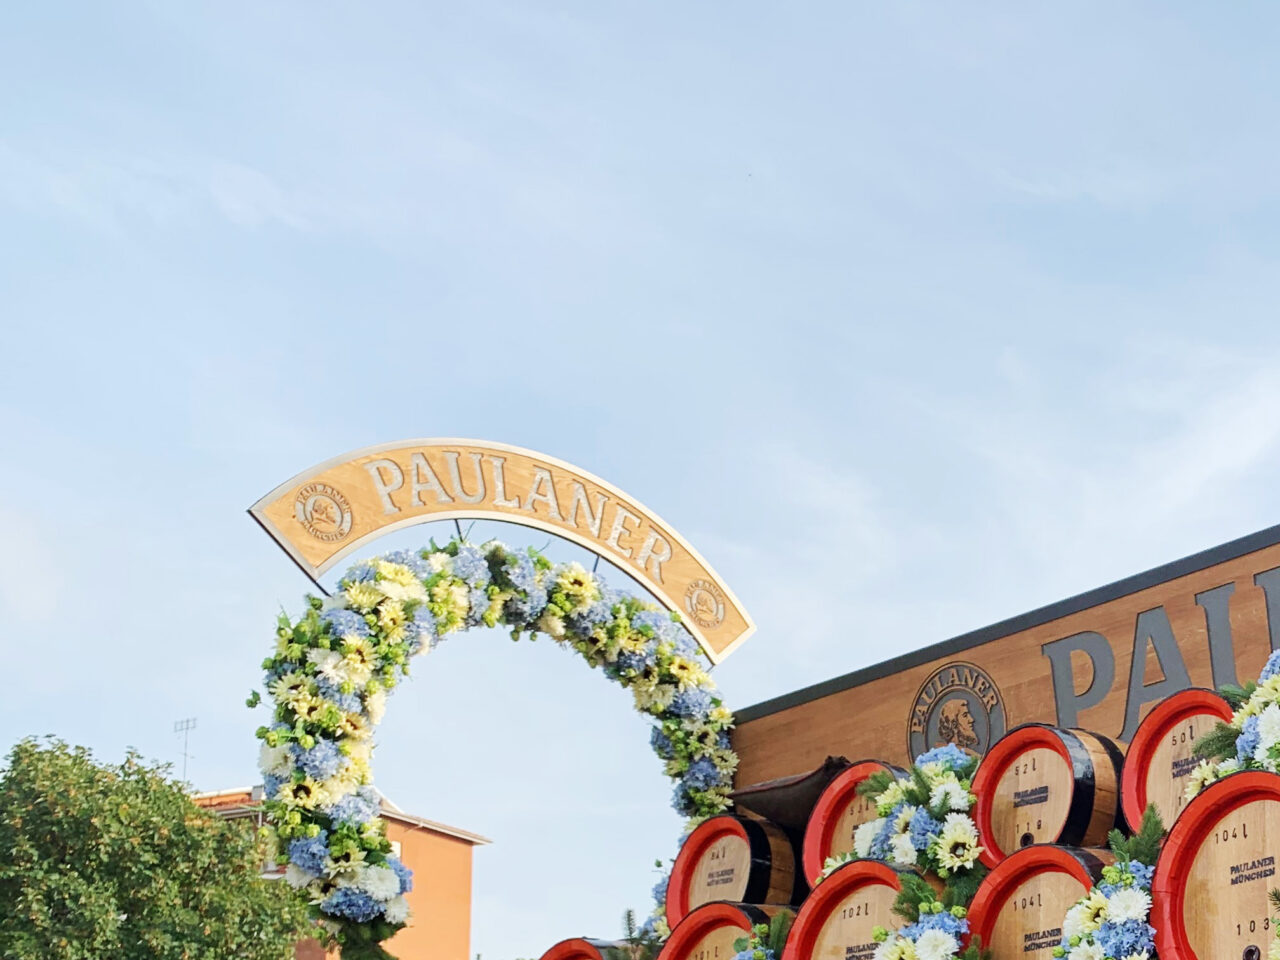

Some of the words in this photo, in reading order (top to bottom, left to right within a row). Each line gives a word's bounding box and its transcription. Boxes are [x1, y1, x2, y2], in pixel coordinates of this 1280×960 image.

[364, 452, 673, 585] PAULANER
[911, 667, 999, 734] PAULANER
[1230, 856, 1276, 875] PAULANER
[1230, 867, 1277, 886] MÜNCHEN
[1024, 928, 1062, 943] PAULANER
[846, 942, 880, 954] PAULANE
